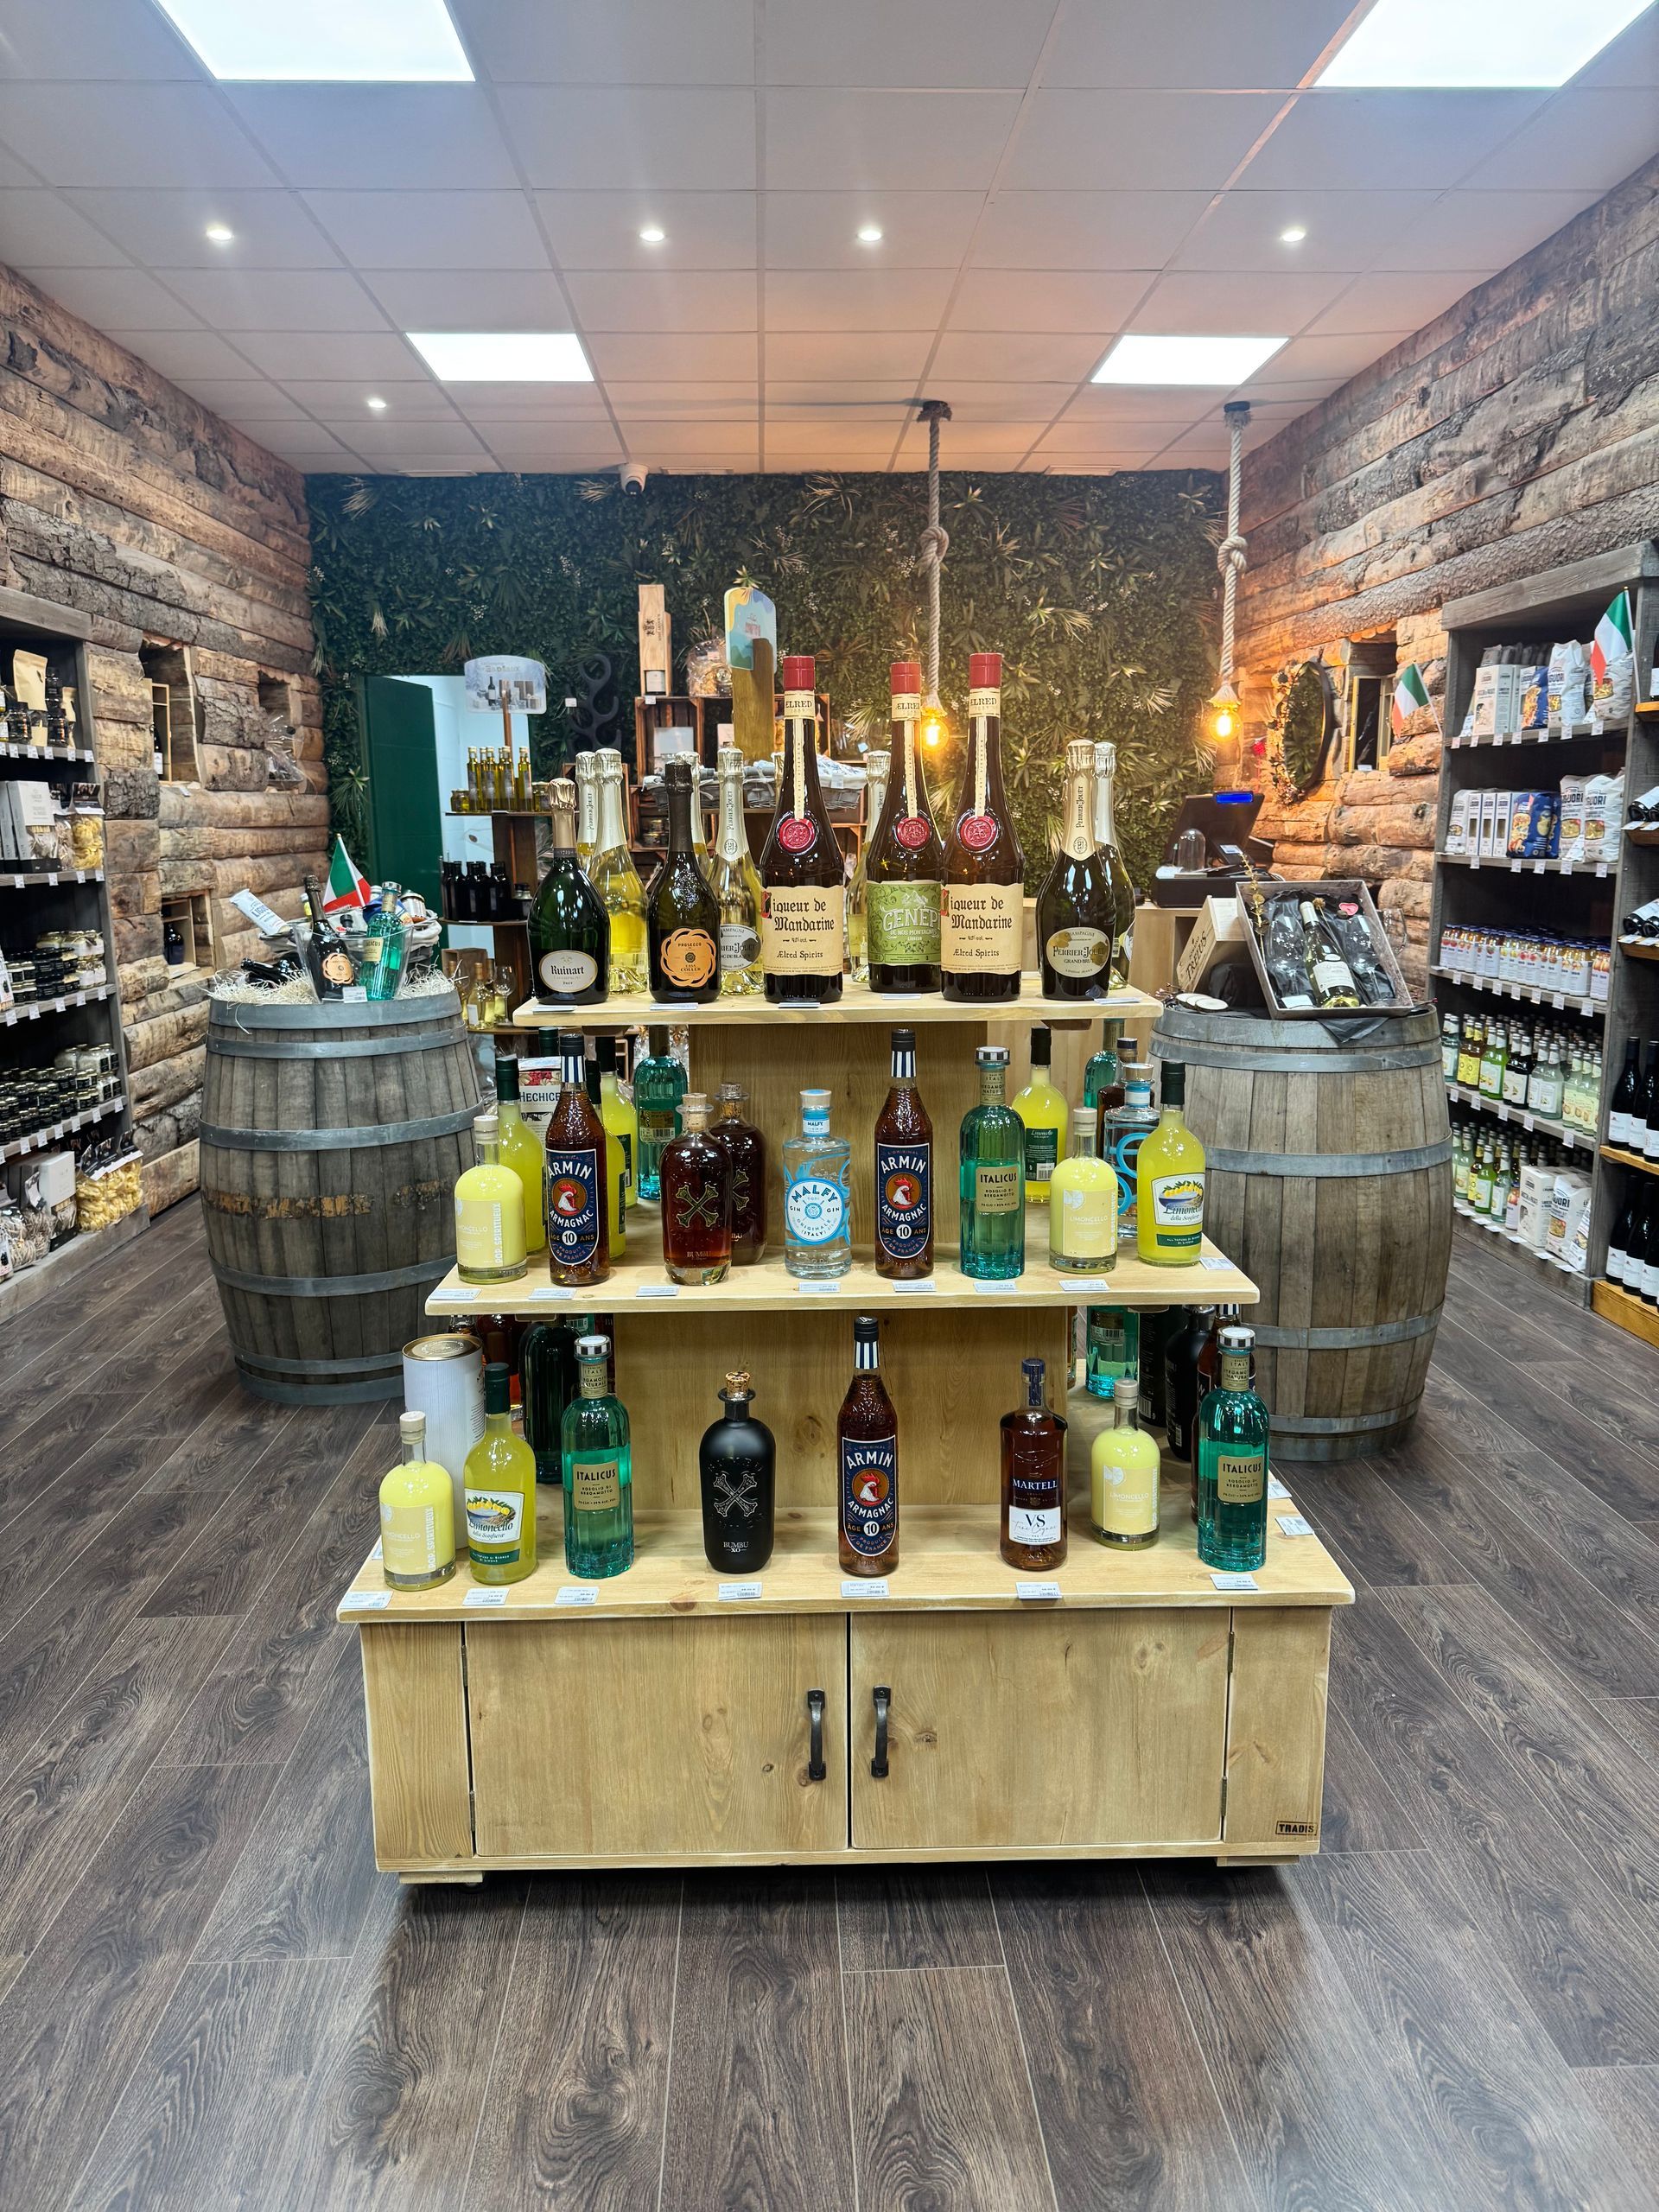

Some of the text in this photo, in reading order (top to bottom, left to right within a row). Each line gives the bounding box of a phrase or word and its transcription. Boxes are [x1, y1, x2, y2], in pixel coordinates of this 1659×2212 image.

[813, 898, 827, 912] de
[991, 896, 1004, 910] de
[774, 916, 835, 931] Mandarine
[951, 914, 1013, 930] Mandarine
[799, 950, 823, 961] Spirits
[975, 949, 1000, 959] Spirits
[550, 964, 585, 975] Ruinart
[547, 1160, 593, 1179] ARMIN
[880, 1155, 927, 1174] ARMIN
[979, 1173, 1018, 1184] ITALICUS
[791, 1184, 838, 1203] MALFY
[550, 1209, 594, 1228] ARMAGNAC
[881, 1203, 927, 1222] ARMAGNAC
[563, 1232, 575, 1243] 10
[898, 1226, 910, 1237] 10
[846, 1451, 893, 1469] ARMIN
[1223, 1462, 1262, 1473] ITALICUS
[576, 1468, 616, 1481] ITALICUS
[1013, 1478, 1058, 1490] MARTELL
[847, 1497, 894, 1519] ARMAGNAC
[1025, 1514, 1046, 1528] VS
[847, 1522, 895, 1535] ÂGE 10 ANS
[864, 1540, 887, 1552] FRANCE
[1279, 1823, 1314, 1834] TRADIS
